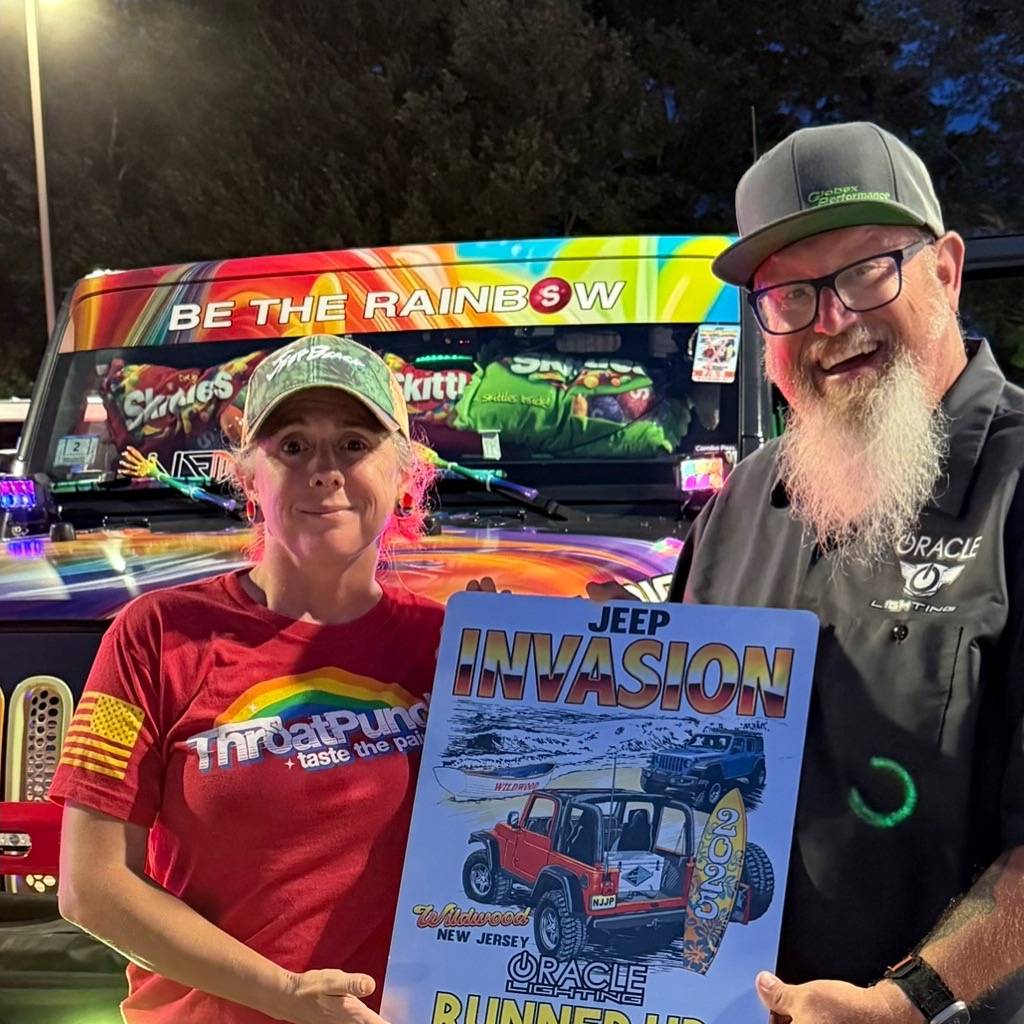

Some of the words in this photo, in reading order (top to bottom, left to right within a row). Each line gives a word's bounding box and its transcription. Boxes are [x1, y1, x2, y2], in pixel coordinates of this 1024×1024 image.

[807, 185, 858, 203] Globex
[169, 302, 233, 331] BE
[253, 293, 347, 325] THE
[897, 532, 983, 560] ORACLE
[870, 600, 957, 612] LIGHTING
[588, 606, 671, 636] JEEP
[452, 628, 795, 719] INVASION
[297, 747, 350, 769] taste
[353, 740, 390, 757] the
[393, 730, 425, 752] pai
[694, 808, 740, 920] 2025
[412, 902, 530, 928] Wildwood
[592, 898, 616, 908] NJJP
[437, 928, 470, 943] NEW
[476, 932, 529, 949] JERSEY
[507, 951, 648, 996] ORACLE
[505, 980, 645, 1006] LIGHTING
